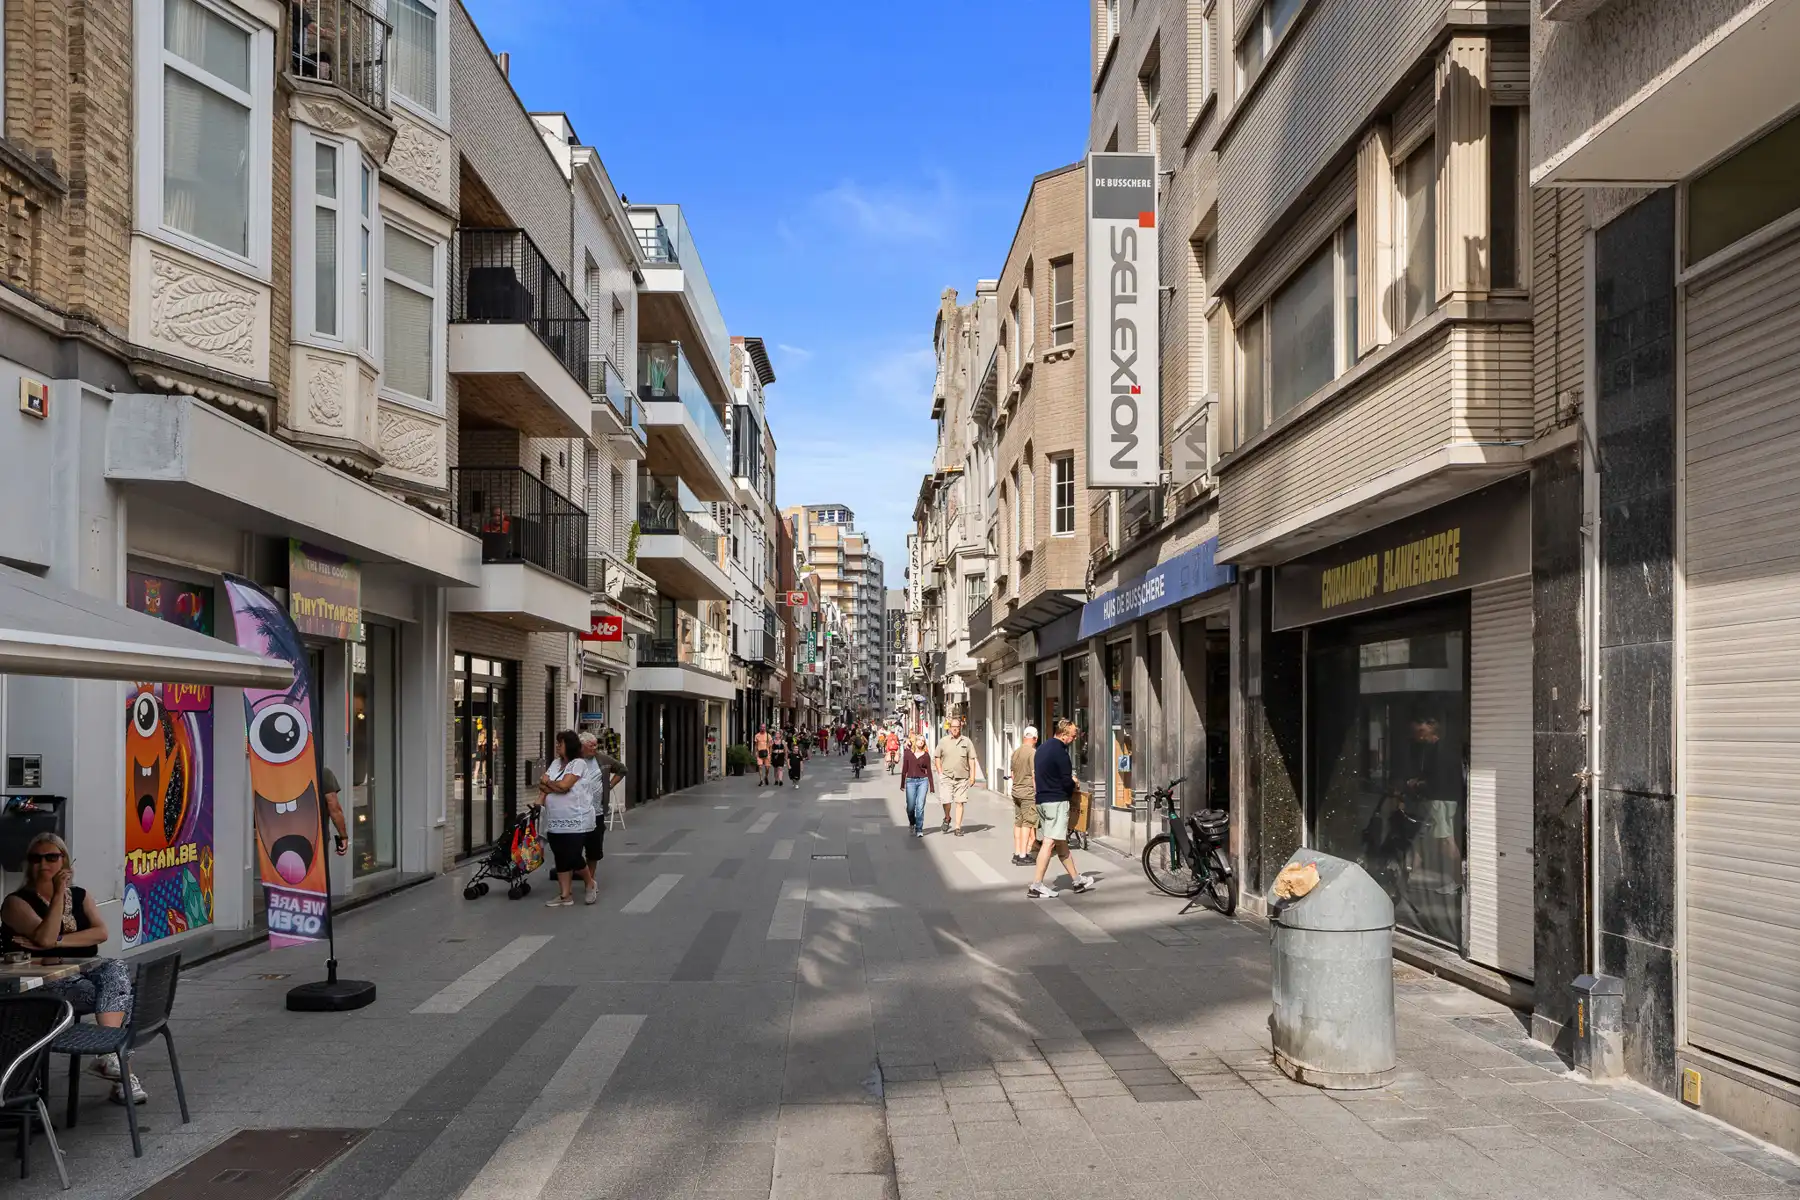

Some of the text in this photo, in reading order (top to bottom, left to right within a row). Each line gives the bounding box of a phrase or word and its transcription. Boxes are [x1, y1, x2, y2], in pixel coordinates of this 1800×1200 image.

[1095, 178, 1152, 188] DE BUSSCHERE
[1110, 226, 1141, 469] SELEXION
[318, 562, 331, 575] FEEL
[332, 565, 348, 579] GOOD
[1322, 527, 1460, 609] GOUDAANKOOP BLANKENBERGE
[1103, 573, 1165, 620] HUIS DE BUSSCHERE
[585, 622, 618, 635] otto
